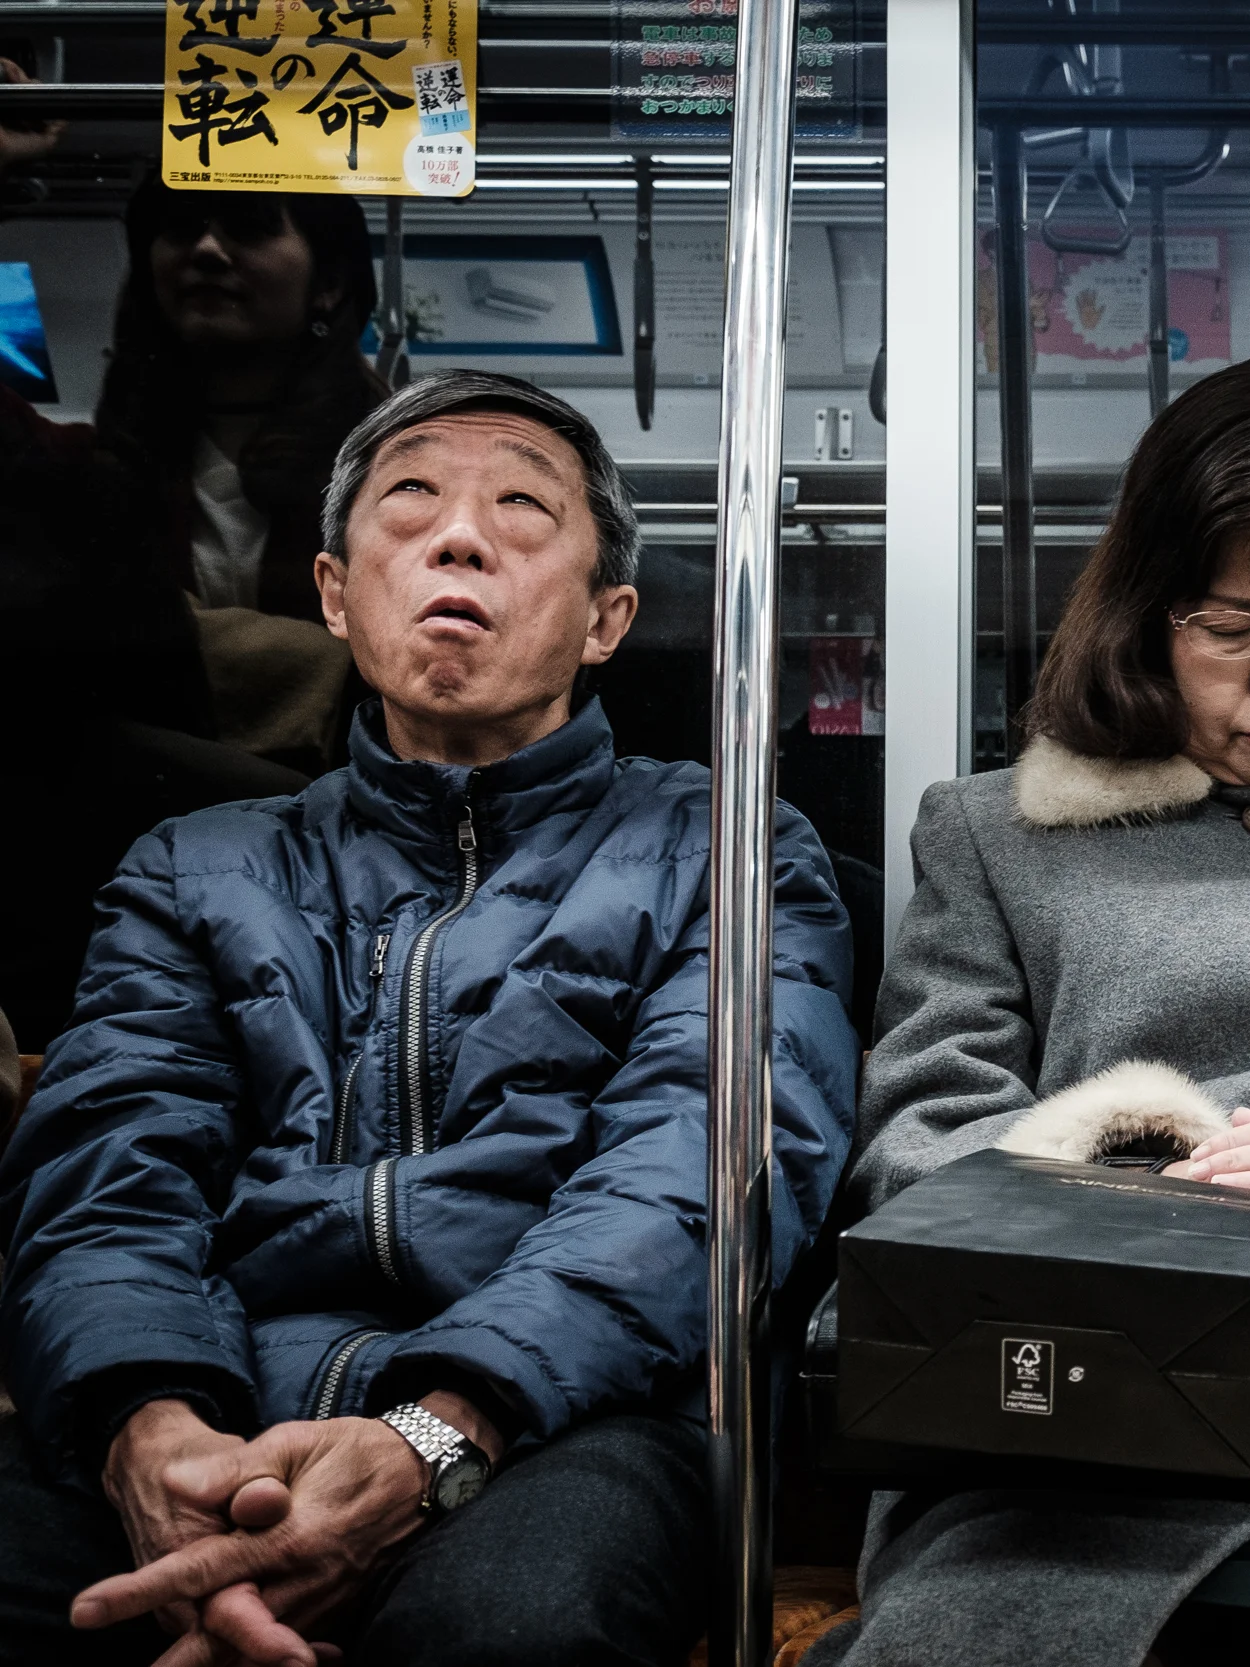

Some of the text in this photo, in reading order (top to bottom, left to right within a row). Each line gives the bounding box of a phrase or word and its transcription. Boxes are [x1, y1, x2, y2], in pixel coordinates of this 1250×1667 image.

[270, 54, 316, 91] の
[440, 66, 466, 111] 運命
[421, 159, 459, 171] 10万部
[169, 171, 211, 182] 三宝出版
[1016, 1367, 1040, 1377] FSC
